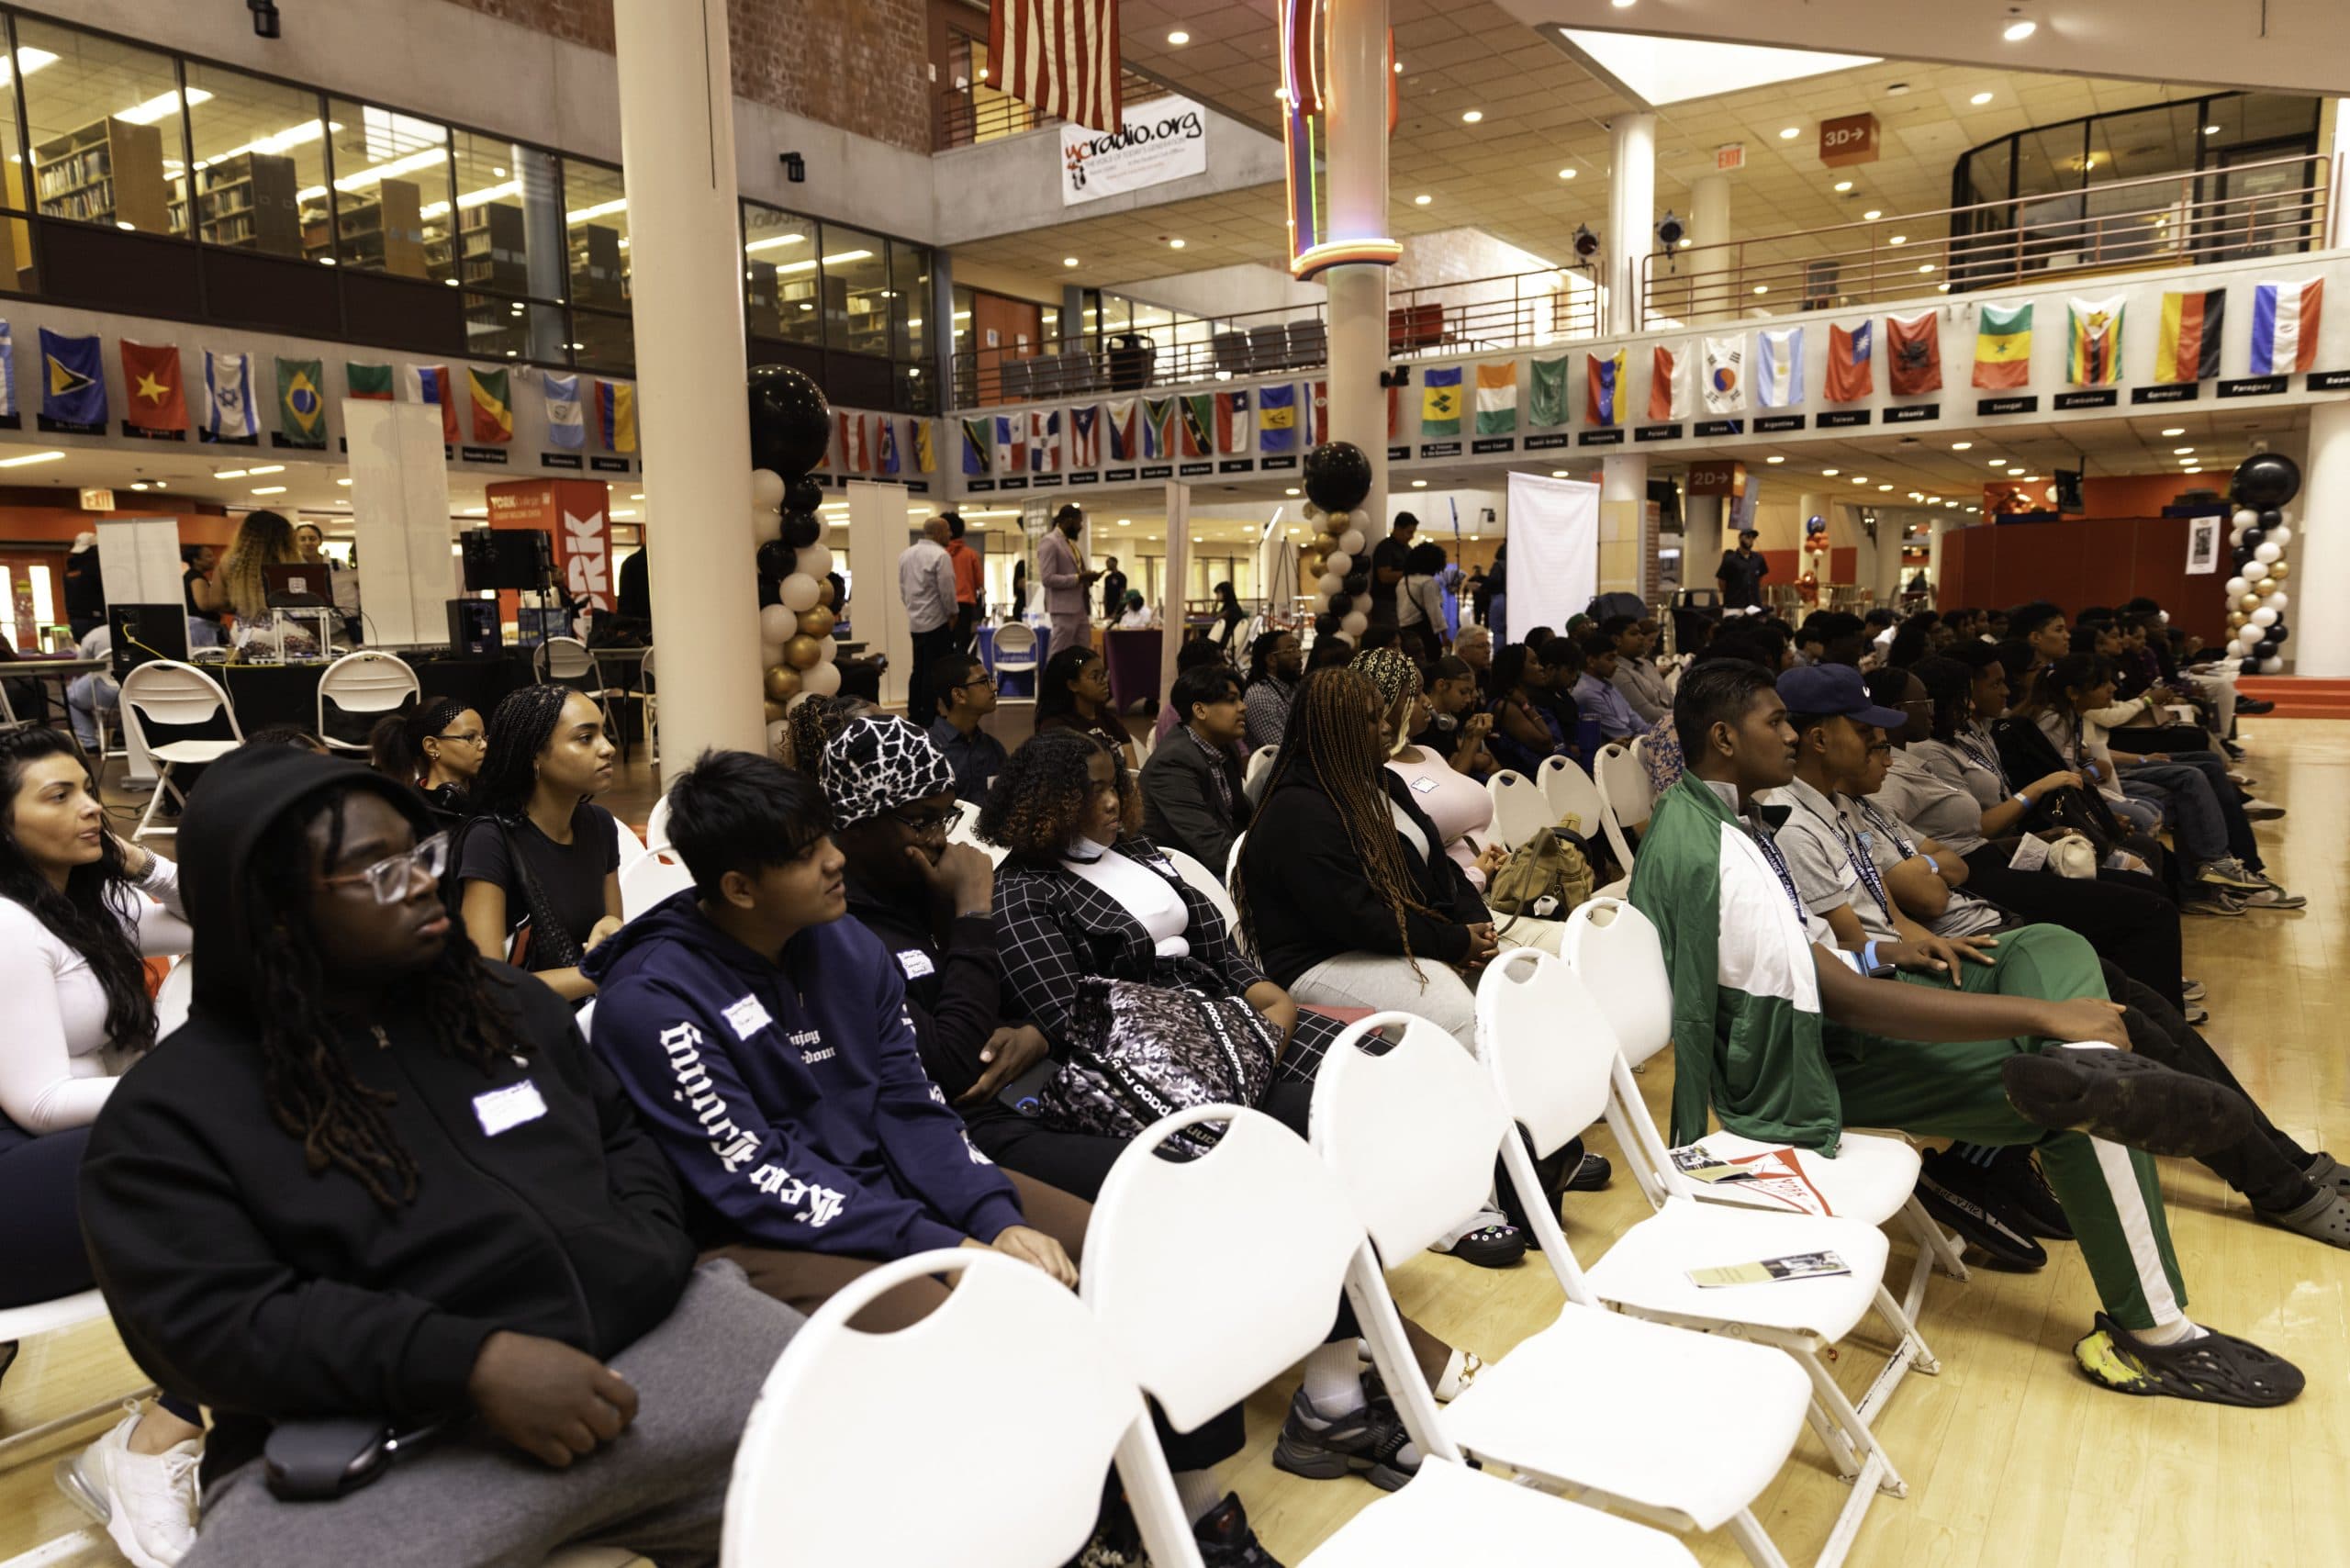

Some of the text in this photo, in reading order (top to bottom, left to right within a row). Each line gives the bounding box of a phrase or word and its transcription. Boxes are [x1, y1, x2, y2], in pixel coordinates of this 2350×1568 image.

[1825, 129, 1850, 147] 3D
[1718, 148, 1741, 169] EXIT
[2146, 390, 2183, 400] Germany
[2232, 384, 2271, 395] Paraguay
[1993, 402, 2021, 411] Senegal
[2065, 397, 2105, 406] Zimbabwe
[1832, 415, 1854, 423] Taiwan
[1898, 409, 1925, 419] Albania
[1763, 420, 1795, 430] Argentina
[1694, 472, 1715, 486] 2D
[86, 491, 111, 510] EXIT
[1782, 876, 1800, 910] ACADEMY
[1201, 1001, 1225, 1031] paco
[786, 1029, 822, 1047] njoy
